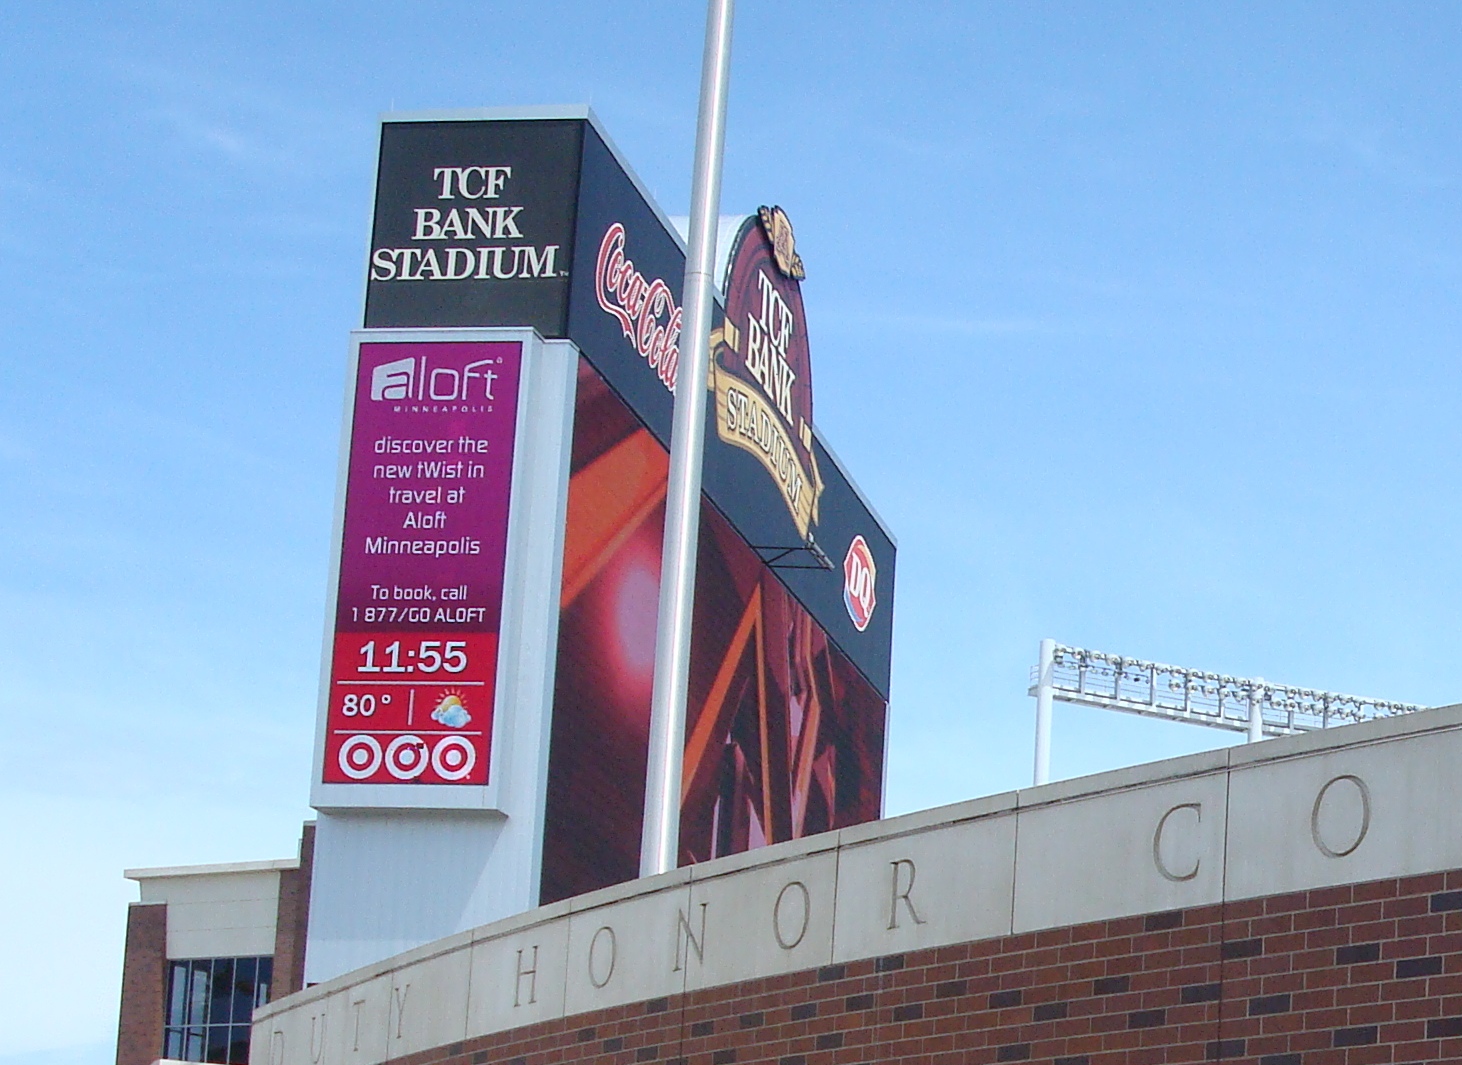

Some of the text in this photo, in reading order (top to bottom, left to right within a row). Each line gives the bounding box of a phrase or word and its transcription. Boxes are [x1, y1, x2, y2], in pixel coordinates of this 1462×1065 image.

[433, 166, 512, 200] TCF
[411, 206, 524, 241] BANK
[370, 245, 560, 281] STADIUM
[757, 268, 793, 357] TCF
[744, 312, 796, 427] BANK
[393, 405, 493, 413] MINNEAPOLIS
[374, 436, 489, 454] discover the
[726, 386, 803, 514] STADIUM
[373, 461, 485, 479] new tWist in
[389, 486, 466, 504] travel at
[402, 511, 447, 529] Aloft
[364, 536, 481, 558] Minneapolis
[370, 585, 468, 602] To book, call
[850, 552, 871, 618] DQ
[351, 607, 358, 623] 1
[434, 607, 487, 623] ALOFT
[357, 640, 468, 673] 11:55
[514, 856, 927, 1008] HONOR
